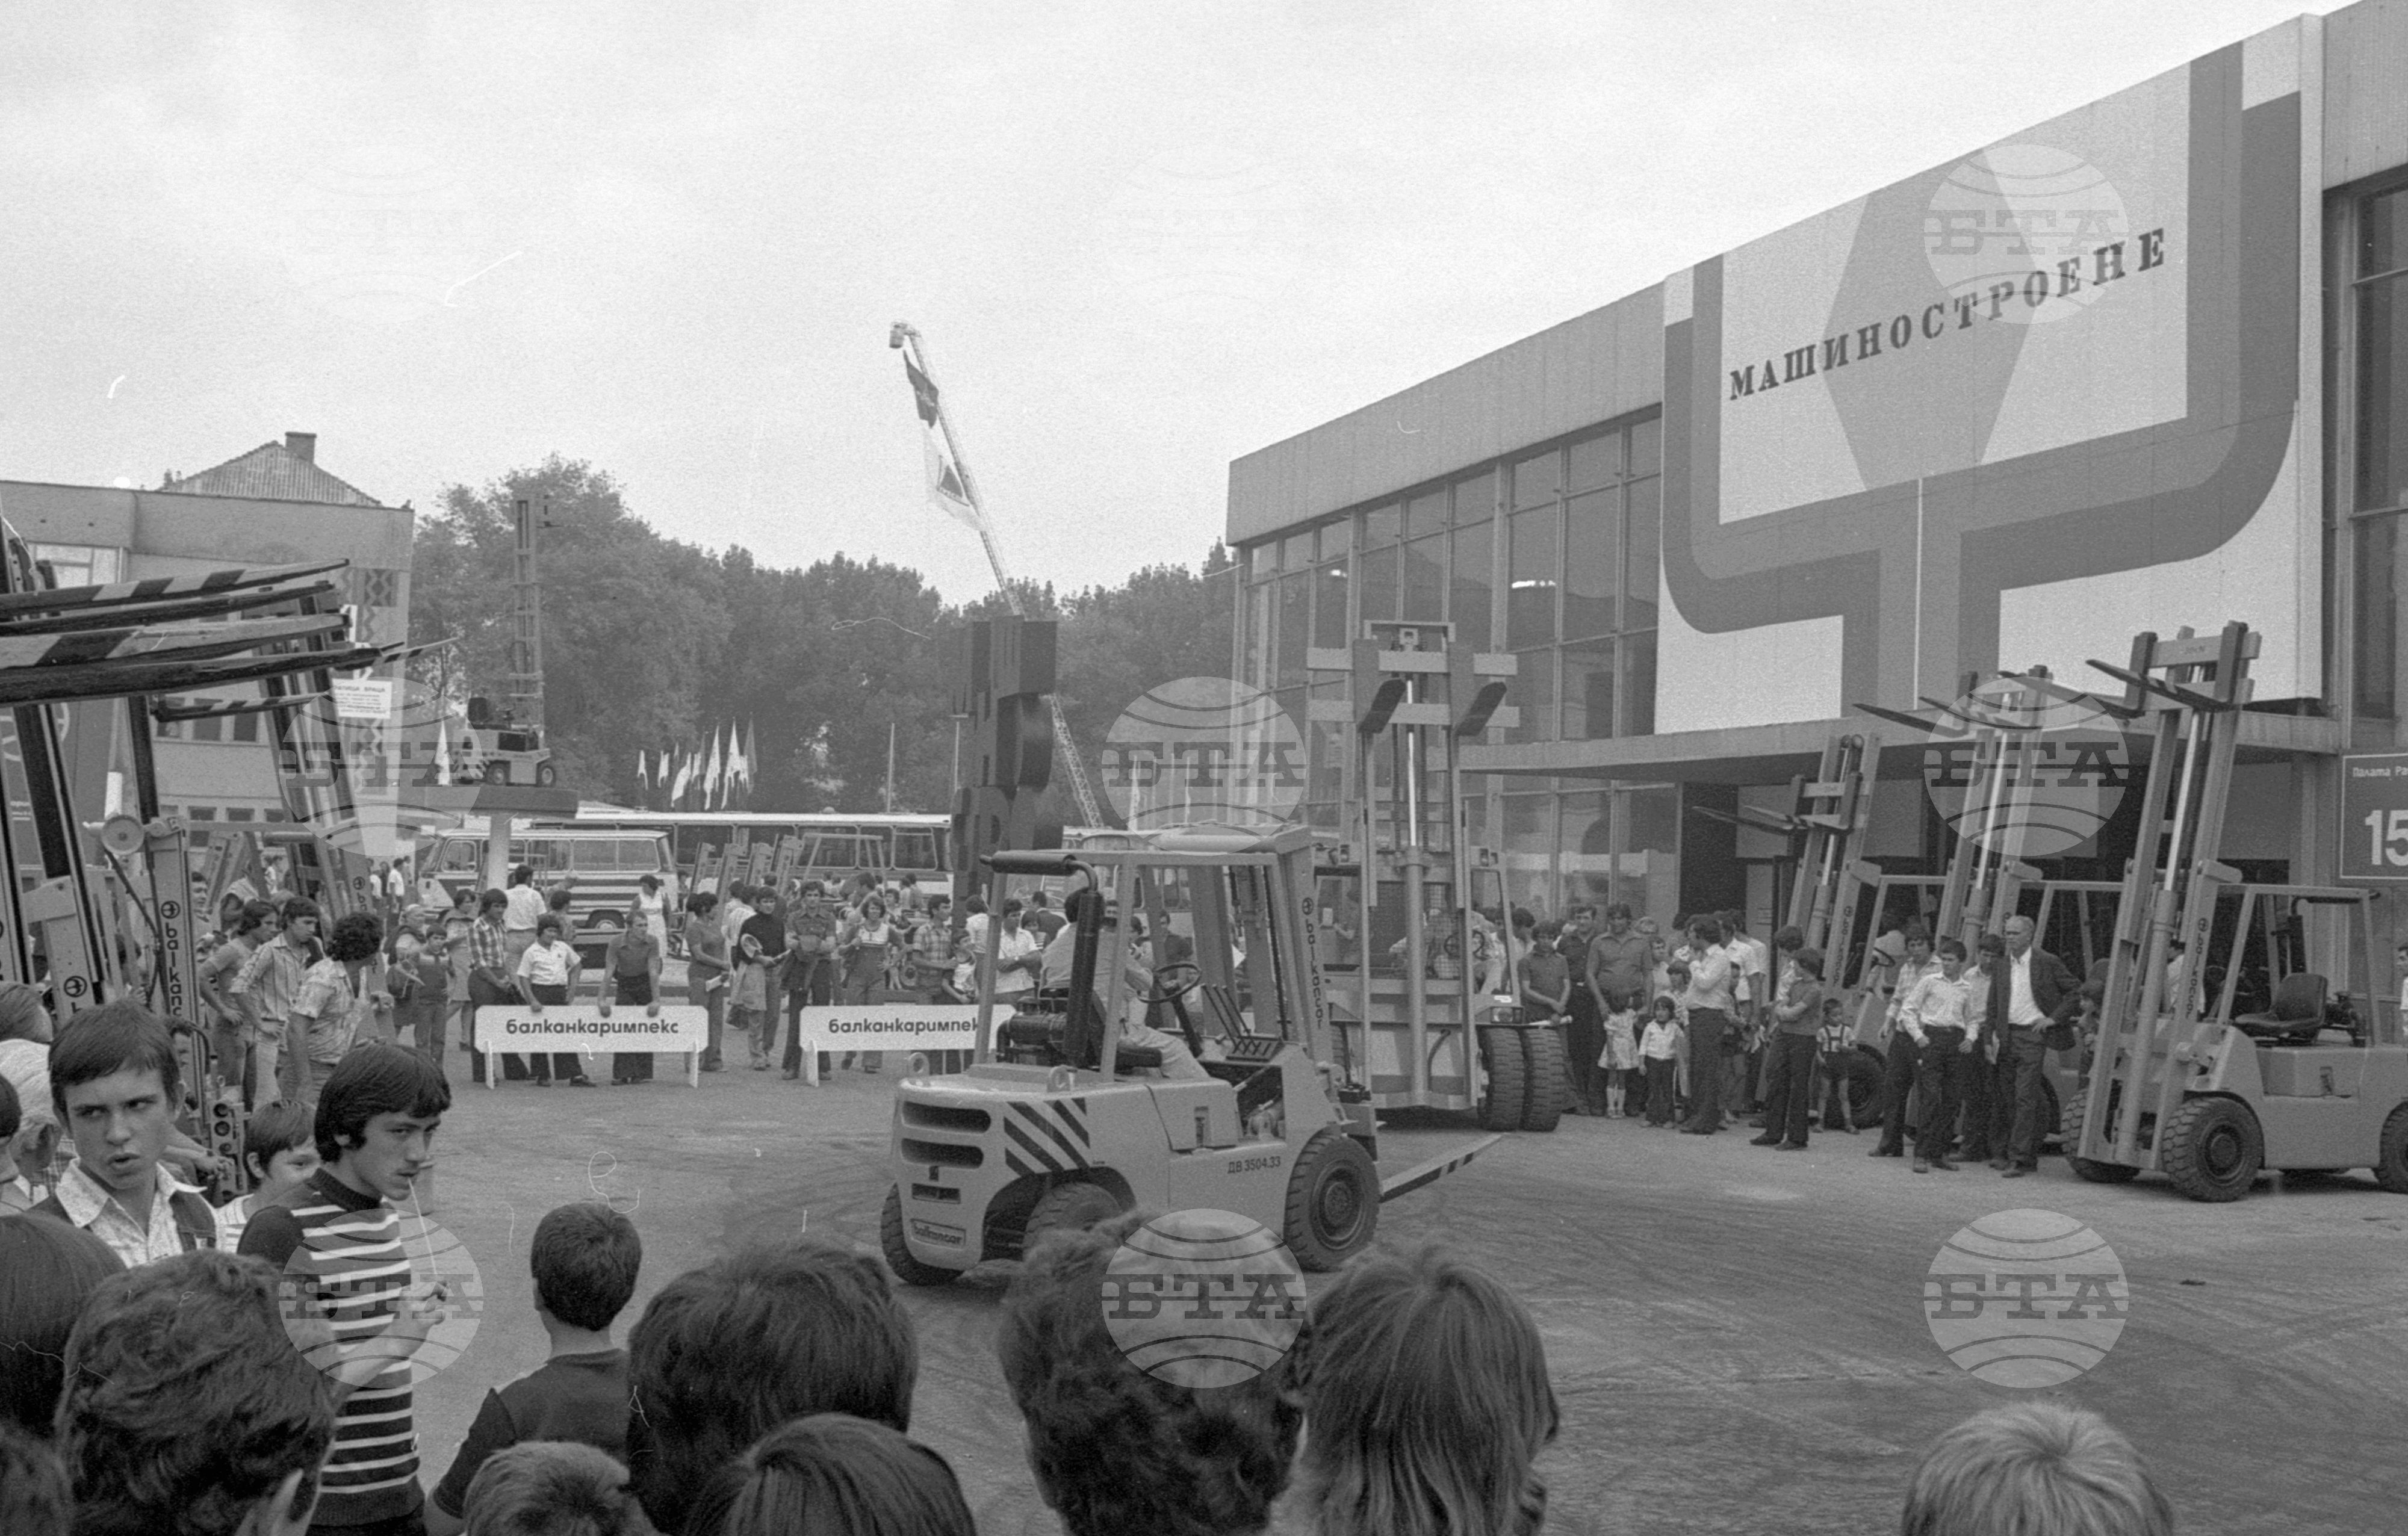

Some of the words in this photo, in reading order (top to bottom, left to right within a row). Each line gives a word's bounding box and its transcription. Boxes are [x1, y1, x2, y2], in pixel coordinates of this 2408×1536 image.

[1730, 228, 2165, 401] МАШИНОСТРОЕНЕ
[2365, 810, 2408, 866] 15
[165, 921, 182, 1017] balkanc
[1305, 918, 1323, 1029] balkancar
[2185, 933, 2204, 1019] balkancar
[506, 1018, 679, 1037] балканкаримпекс
[828, 1017, 978, 1036] балканкаримпек
[1227, 1160, 1242, 1174] ДВ
